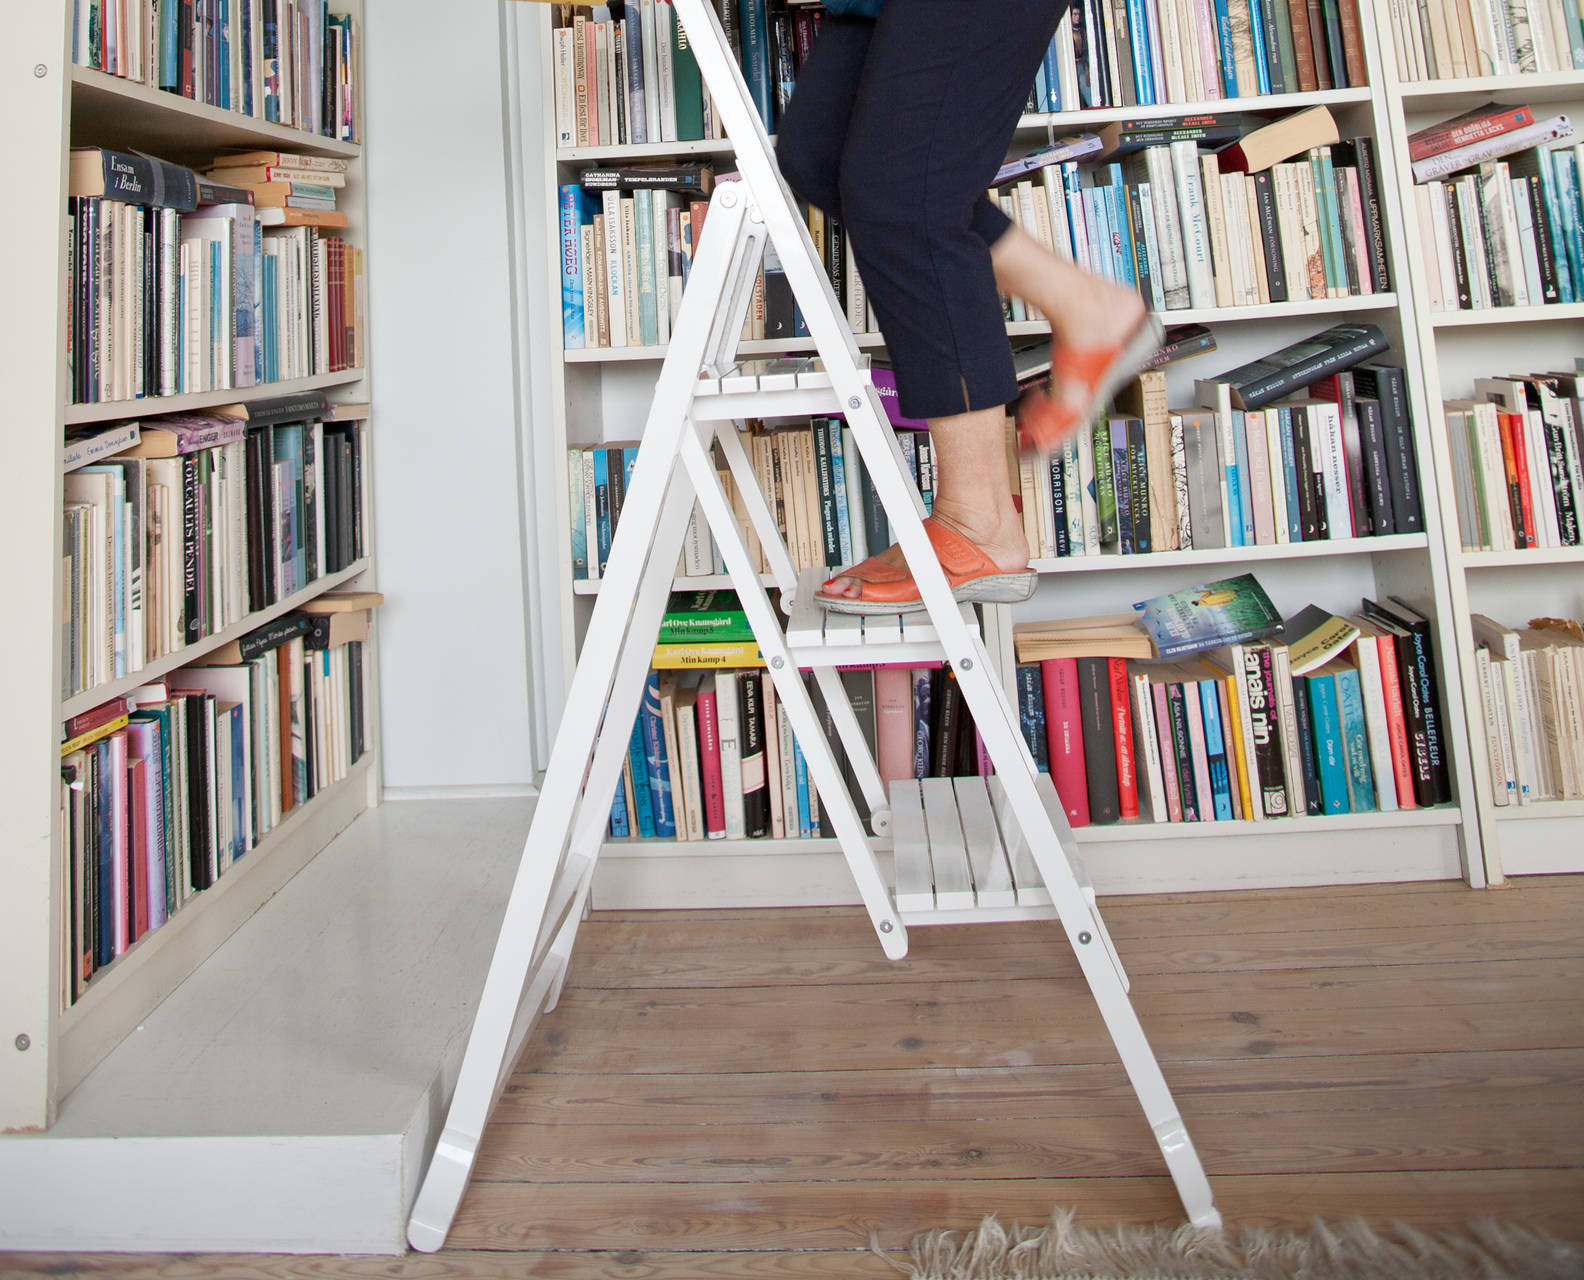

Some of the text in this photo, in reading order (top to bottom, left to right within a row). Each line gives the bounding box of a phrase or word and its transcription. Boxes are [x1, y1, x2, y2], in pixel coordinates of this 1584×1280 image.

[110, 155, 135, 174] Ensam
[119, 173, 142, 193] Berlin
[563, 192, 578, 236] PETER
[185, 541, 196, 597] PENDEL
[1263, 651, 1272, 668] the
[1412, 632, 1440, 766] Joyce Carol Oates BELLEFLEUR
[1251, 713, 1273, 744] nin
